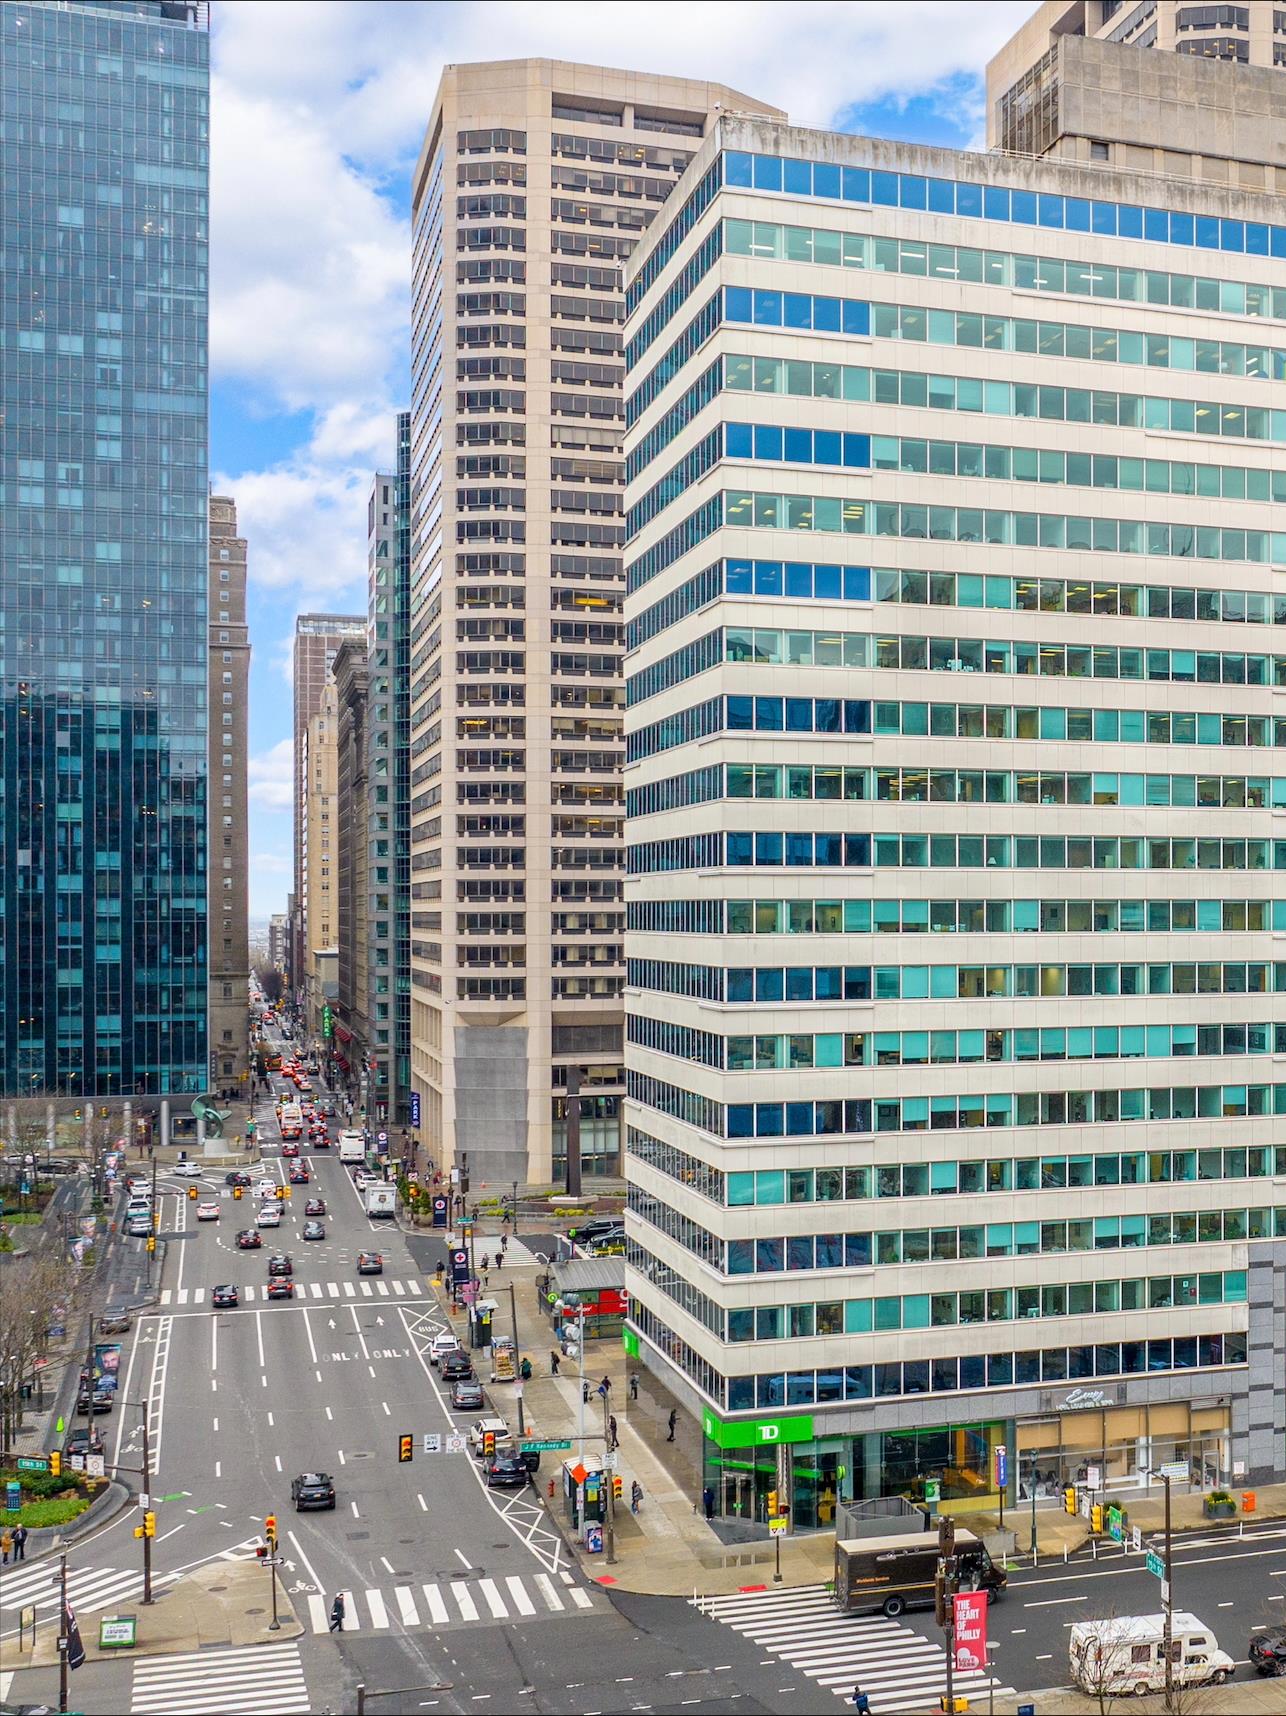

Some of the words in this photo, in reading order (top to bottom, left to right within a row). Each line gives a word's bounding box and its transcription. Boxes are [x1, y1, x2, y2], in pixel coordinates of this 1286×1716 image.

[373, 1349, 410, 1359] ONLY
[758, 1425, 779, 1440] TD
[956, 1600, 970, 1610] THE
[957, 1608, 980, 1620] HEART
[957, 1620, 967, 1631] OF
[957, 1629, 981, 1641] PHILLY
